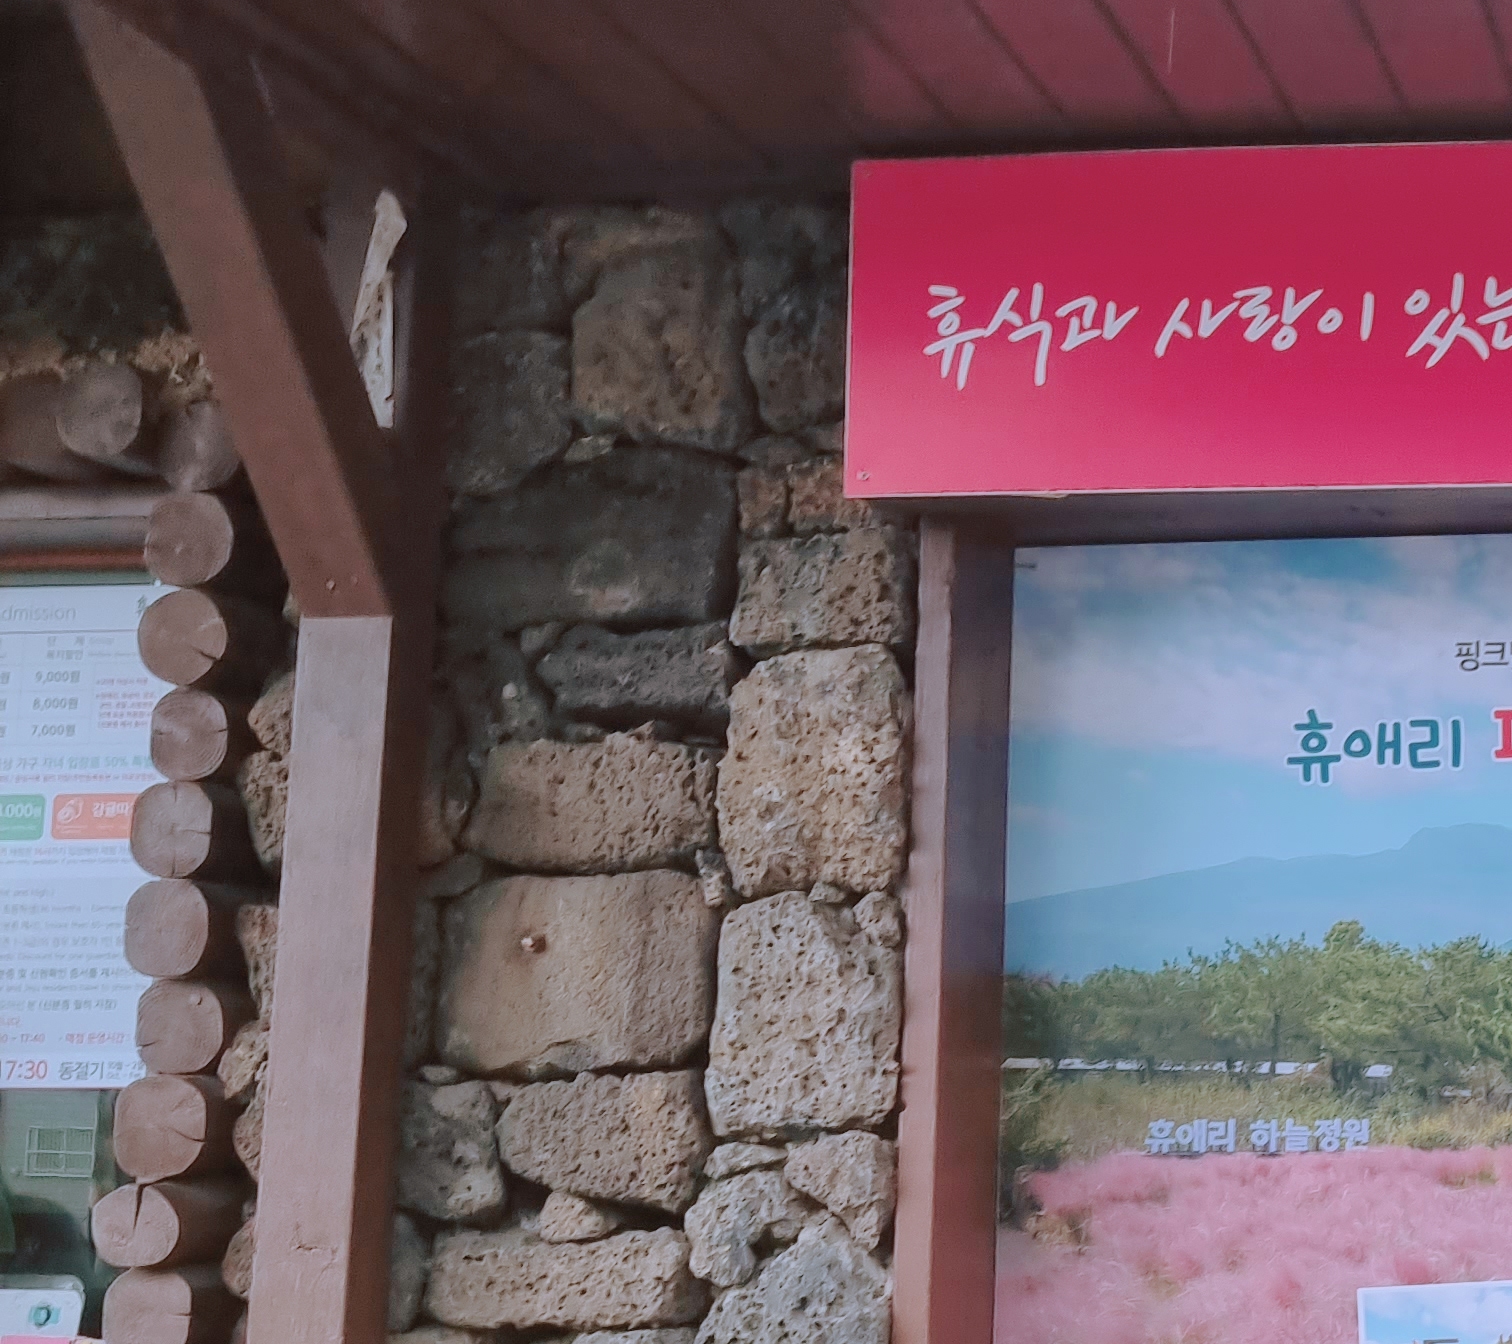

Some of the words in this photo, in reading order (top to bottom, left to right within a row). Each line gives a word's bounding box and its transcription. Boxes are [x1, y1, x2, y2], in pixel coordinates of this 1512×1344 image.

[923, 281, 1138, 391] 휴식과
[1154, 288, 1375, 359] 사랑이
[1285, 709, 1463, 785] 휴애리
[59, 1060, 104, 1081] 동절기
